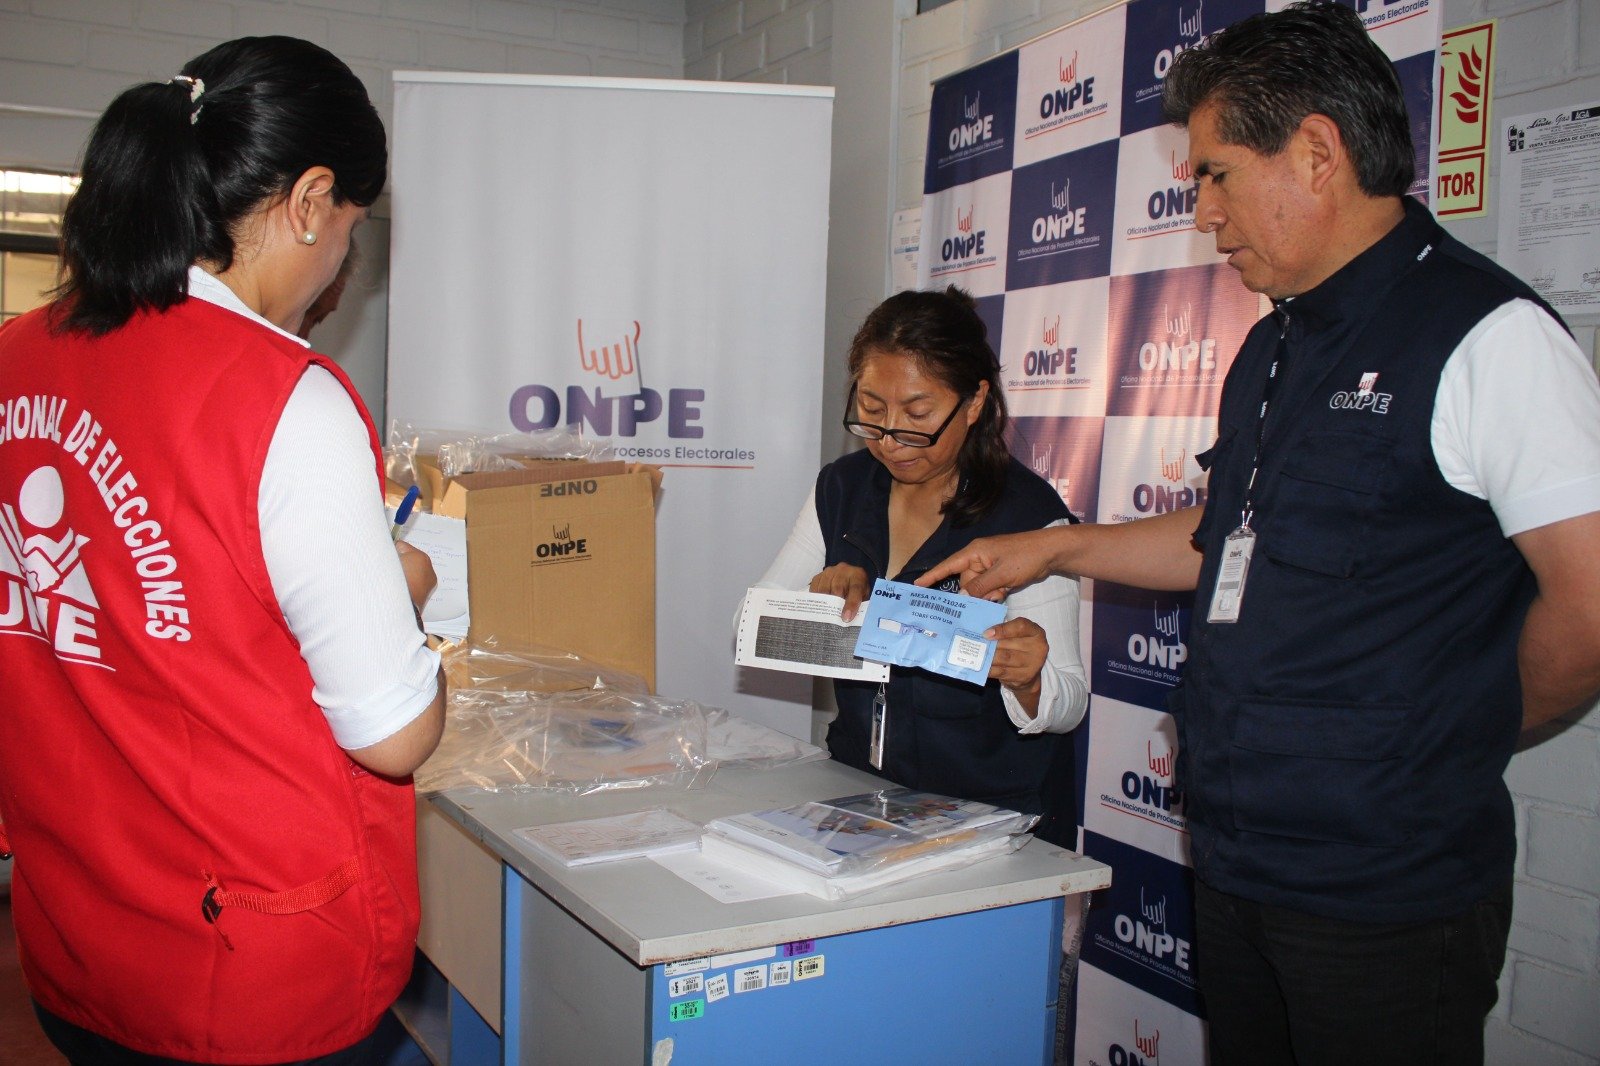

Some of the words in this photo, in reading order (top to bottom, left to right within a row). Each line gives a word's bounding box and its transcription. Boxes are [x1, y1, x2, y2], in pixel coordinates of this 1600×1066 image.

[1387, 0, 1429, 18] Electorales
[1040, 77, 1094, 118] ONPE
[1025, 126, 1040, 135] Oficina
[1040, 121, 1057, 131] Nacional
[1064, 112, 1083, 123] Procesos
[1084, 102, 1108, 116] Electorales
[949, 115, 993, 151] ONPE
[1032, 207, 1086, 243] ONPE
[1127, 226, 1147, 235] Oficina
[1148, 221, 1170, 232] Nacional
[942, 230, 985, 262] ONPE
[1018, 248, 1031, 256] Oficina
[1032, 244, 1049, 254] Nacional
[1057, 240, 1074, 249] Procesos
[1075, 235, 1100, 245] Electorales
[1417, 244, 1432, 261] ONPE
[1024, 348, 1077, 376] ONPE
[1139, 339, 1216, 370] ONPE
[509, 384, 705, 439] ONPE
[1329, 391, 1392, 414] ONPE
[675, 446, 755, 460] Electorales
[540, 480, 598, 497] ONPE
[63, 410, 102, 466] DE
[88, 438, 192, 642] ELECCIONES
[536, 539, 586, 558] ONPE
[875, 589, 902, 600] ONPE
[910, 592, 929, 600] MESA
[912, 611, 928, 619] SOBRE
[1108, 660, 1128, 670] Oficina
[1128, 664, 1153, 676] Nacional
[1101, 794, 1120, 805] Oficina
[1122, 800, 1147, 814] Nacional
[1149, 810, 1156, 818] de
[1157, 812, 1183, 827] Procesos
[1115, 914, 1190, 970] ONPE
[1116, 942, 1140, 958] Nacional
[1149, 958, 1176, 975] Procesos
